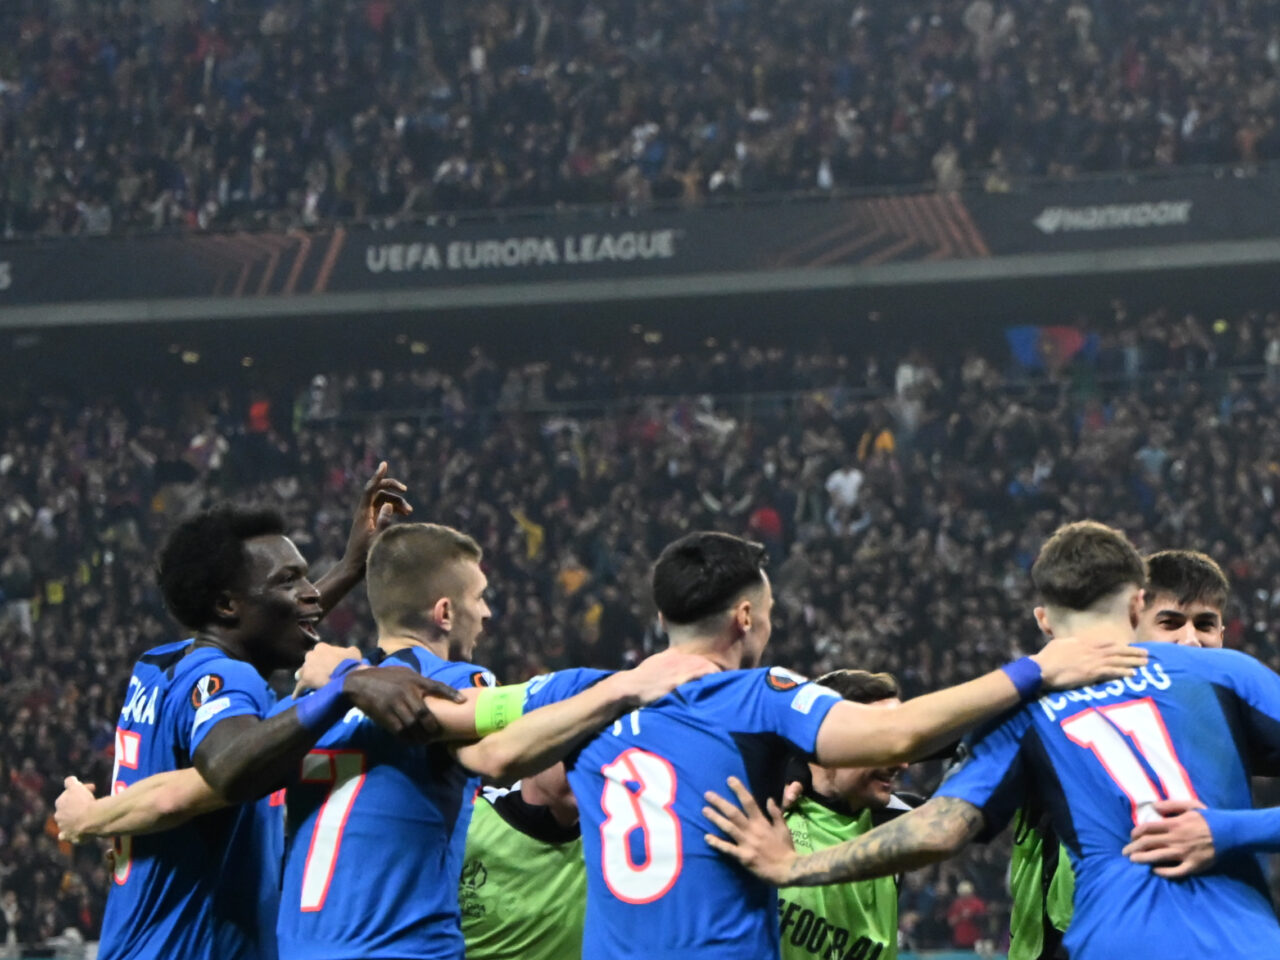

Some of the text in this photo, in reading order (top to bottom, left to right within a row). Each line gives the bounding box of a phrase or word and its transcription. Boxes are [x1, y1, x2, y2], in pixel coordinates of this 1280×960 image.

[366, 228, 676, 273] UEFA EUROPA LEAGUE
[300, 748, 367, 912] 7
[600, 747, 683, 905] 8
[1060, 697, 1199, 826] 11
